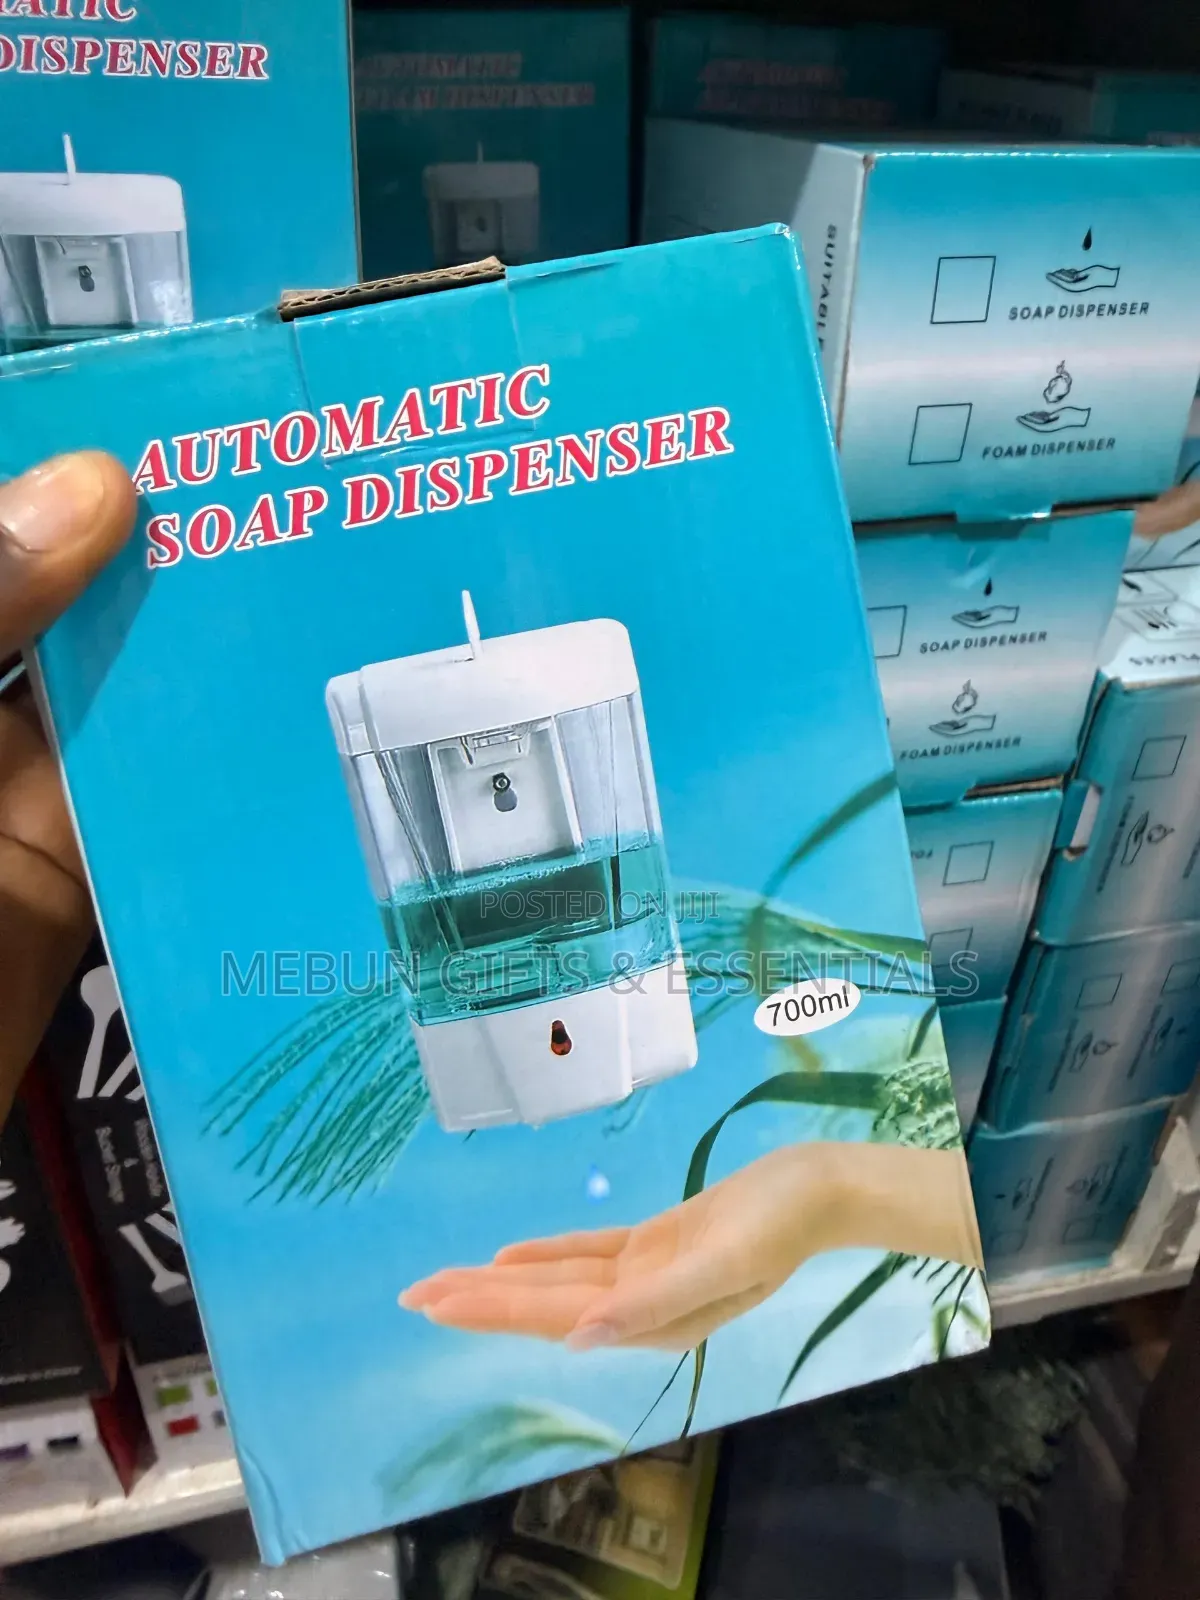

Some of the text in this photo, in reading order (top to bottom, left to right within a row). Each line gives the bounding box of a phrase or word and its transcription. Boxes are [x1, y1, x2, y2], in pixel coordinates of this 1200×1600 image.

[1008, 301, 1150, 321] SOAP DISPENSER
[132, 363, 551, 495] AUTOMATIC
[982, 437, 1117, 460] FOAM DISPENSER
[146, 406, 734, 568] SOAP DISPENSER
[919, 631, 1048, 654] SOAP DISPENSER
[943, 736, 1022, 756] DISPENSER
[766, 985, 850, 1027] 700ml
